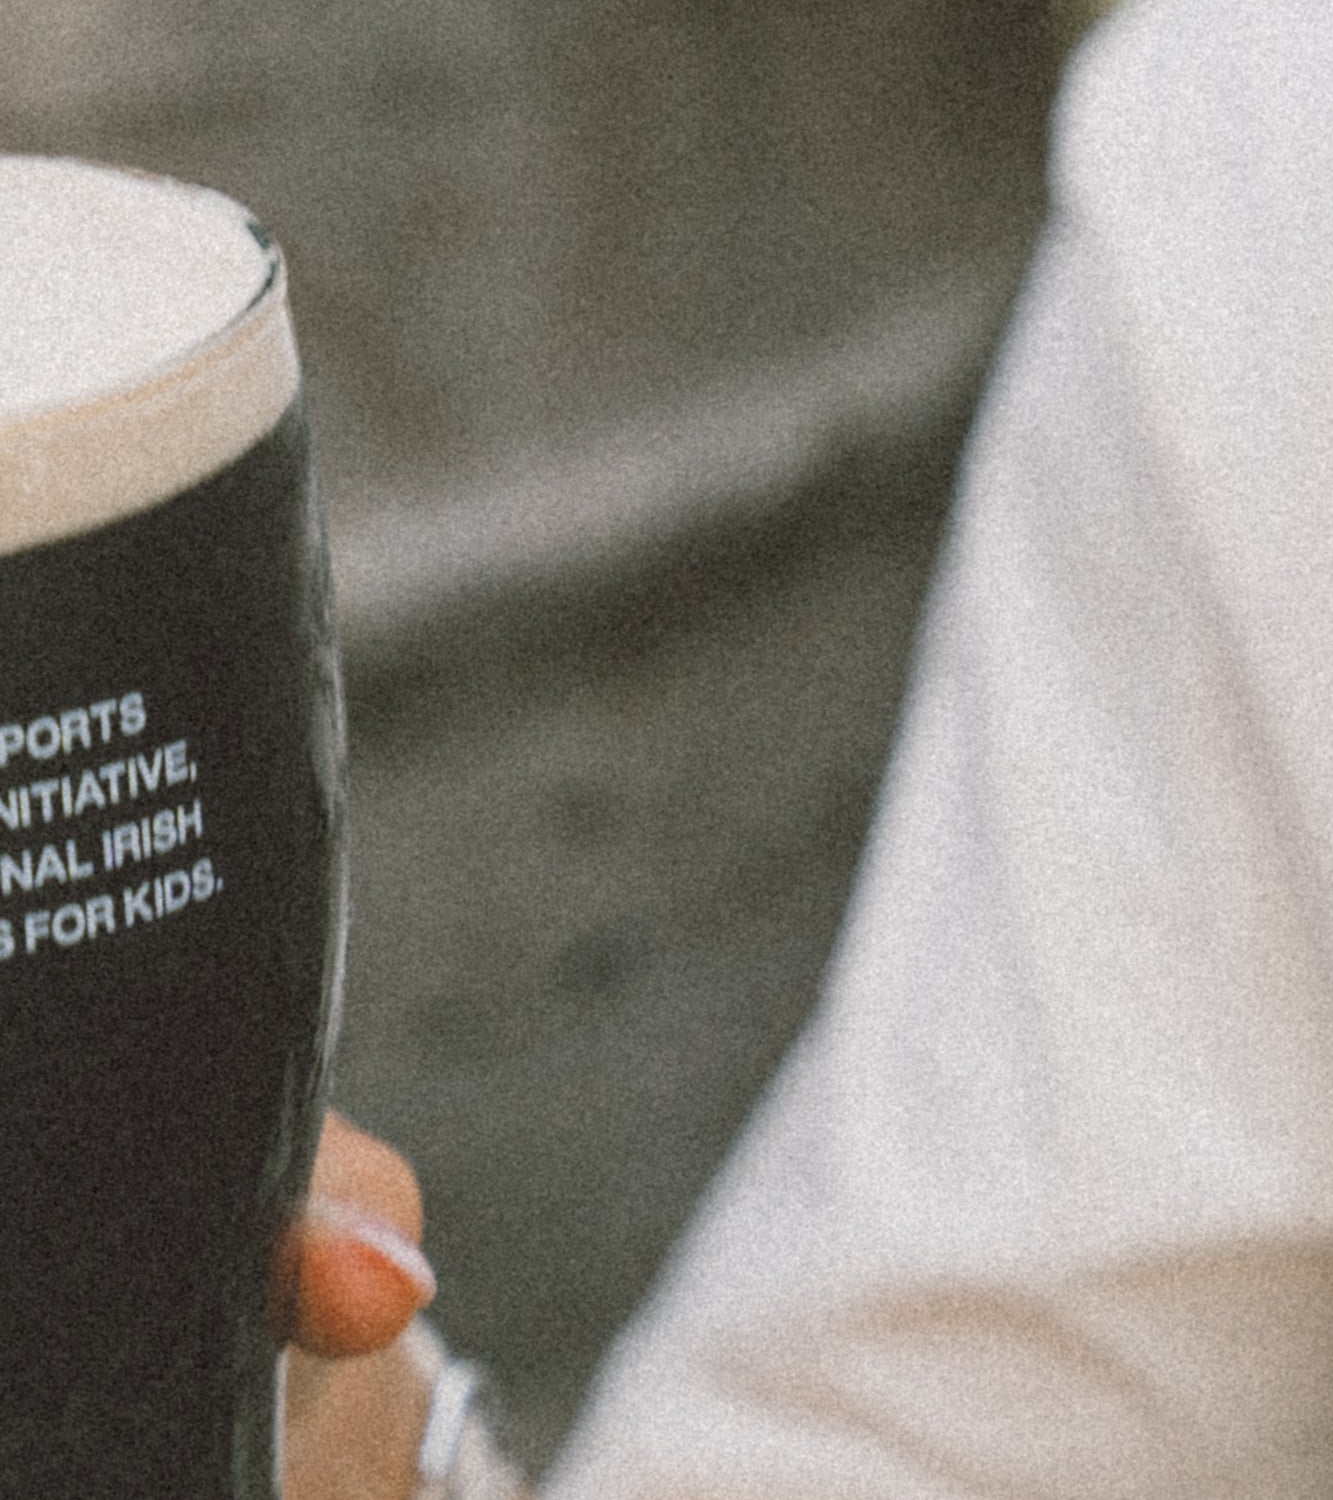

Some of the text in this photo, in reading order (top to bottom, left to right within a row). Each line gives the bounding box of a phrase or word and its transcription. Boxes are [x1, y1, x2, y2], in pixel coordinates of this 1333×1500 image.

[0, 691, 147, 768] PORTS
[0, 799, 204, 896] NAL IRISH
[25, 894, 116, 954] FOR
[123, 857, 225, 928] KIDS.
